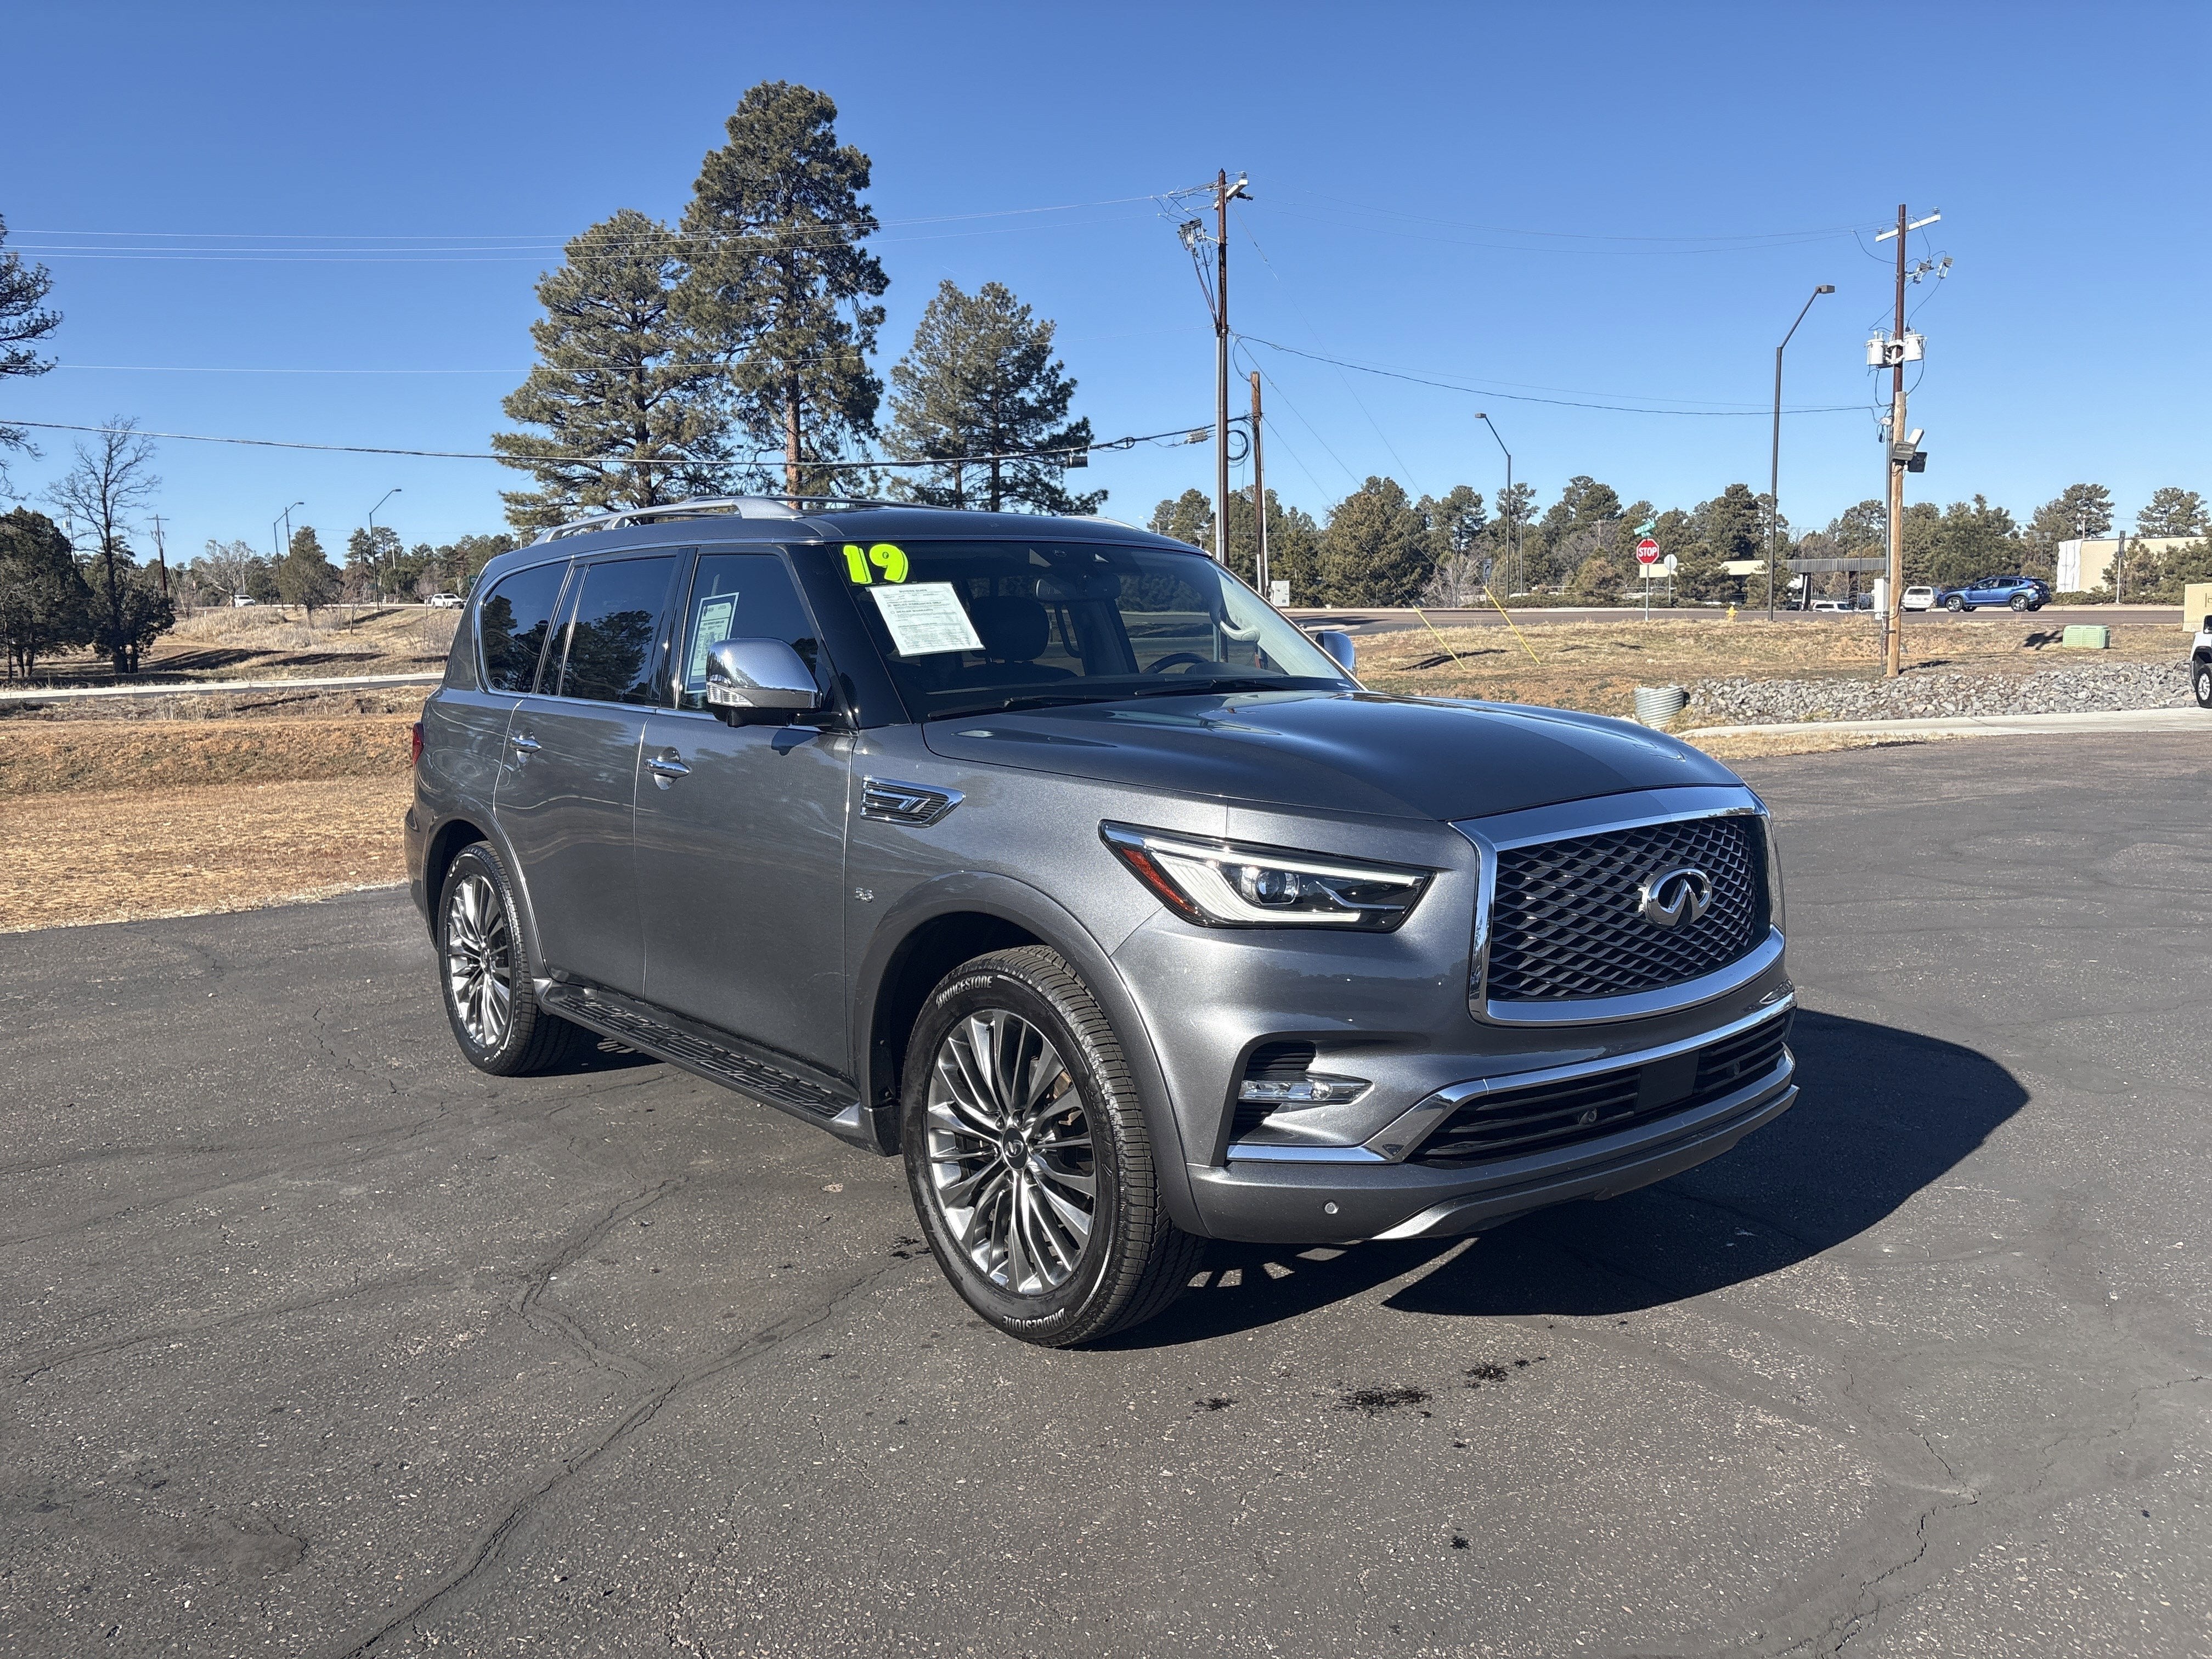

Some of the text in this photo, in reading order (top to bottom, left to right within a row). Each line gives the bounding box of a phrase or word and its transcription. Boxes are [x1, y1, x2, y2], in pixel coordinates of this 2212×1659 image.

[843, 544, 908, 584] 19
[1638, 546, 1657, 557] STOP
[935, 975, 992, 1010] BRIDGESTONE
[1002, 1307, 1070, 1333] BRIDGESTONE
